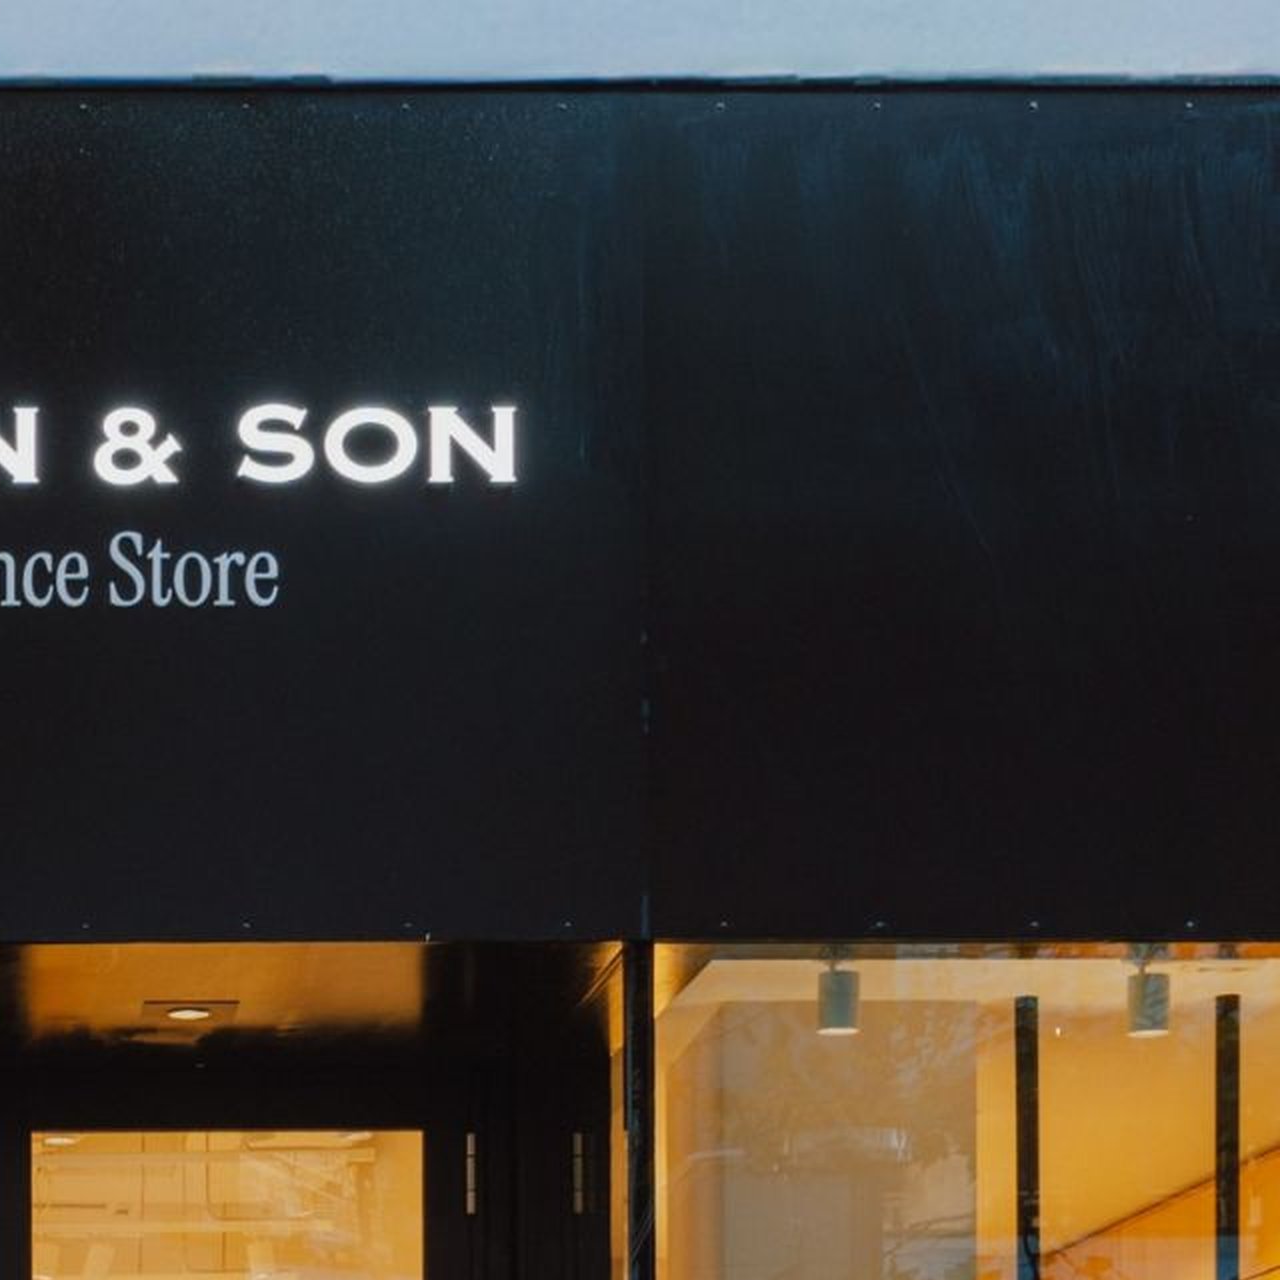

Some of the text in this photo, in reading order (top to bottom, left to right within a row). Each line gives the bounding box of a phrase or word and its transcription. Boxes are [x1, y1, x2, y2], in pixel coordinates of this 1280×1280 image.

[92, 405, 183, 487] &
[235, 402, 518, 485] SON
[108, 530, 280, 608] Store
